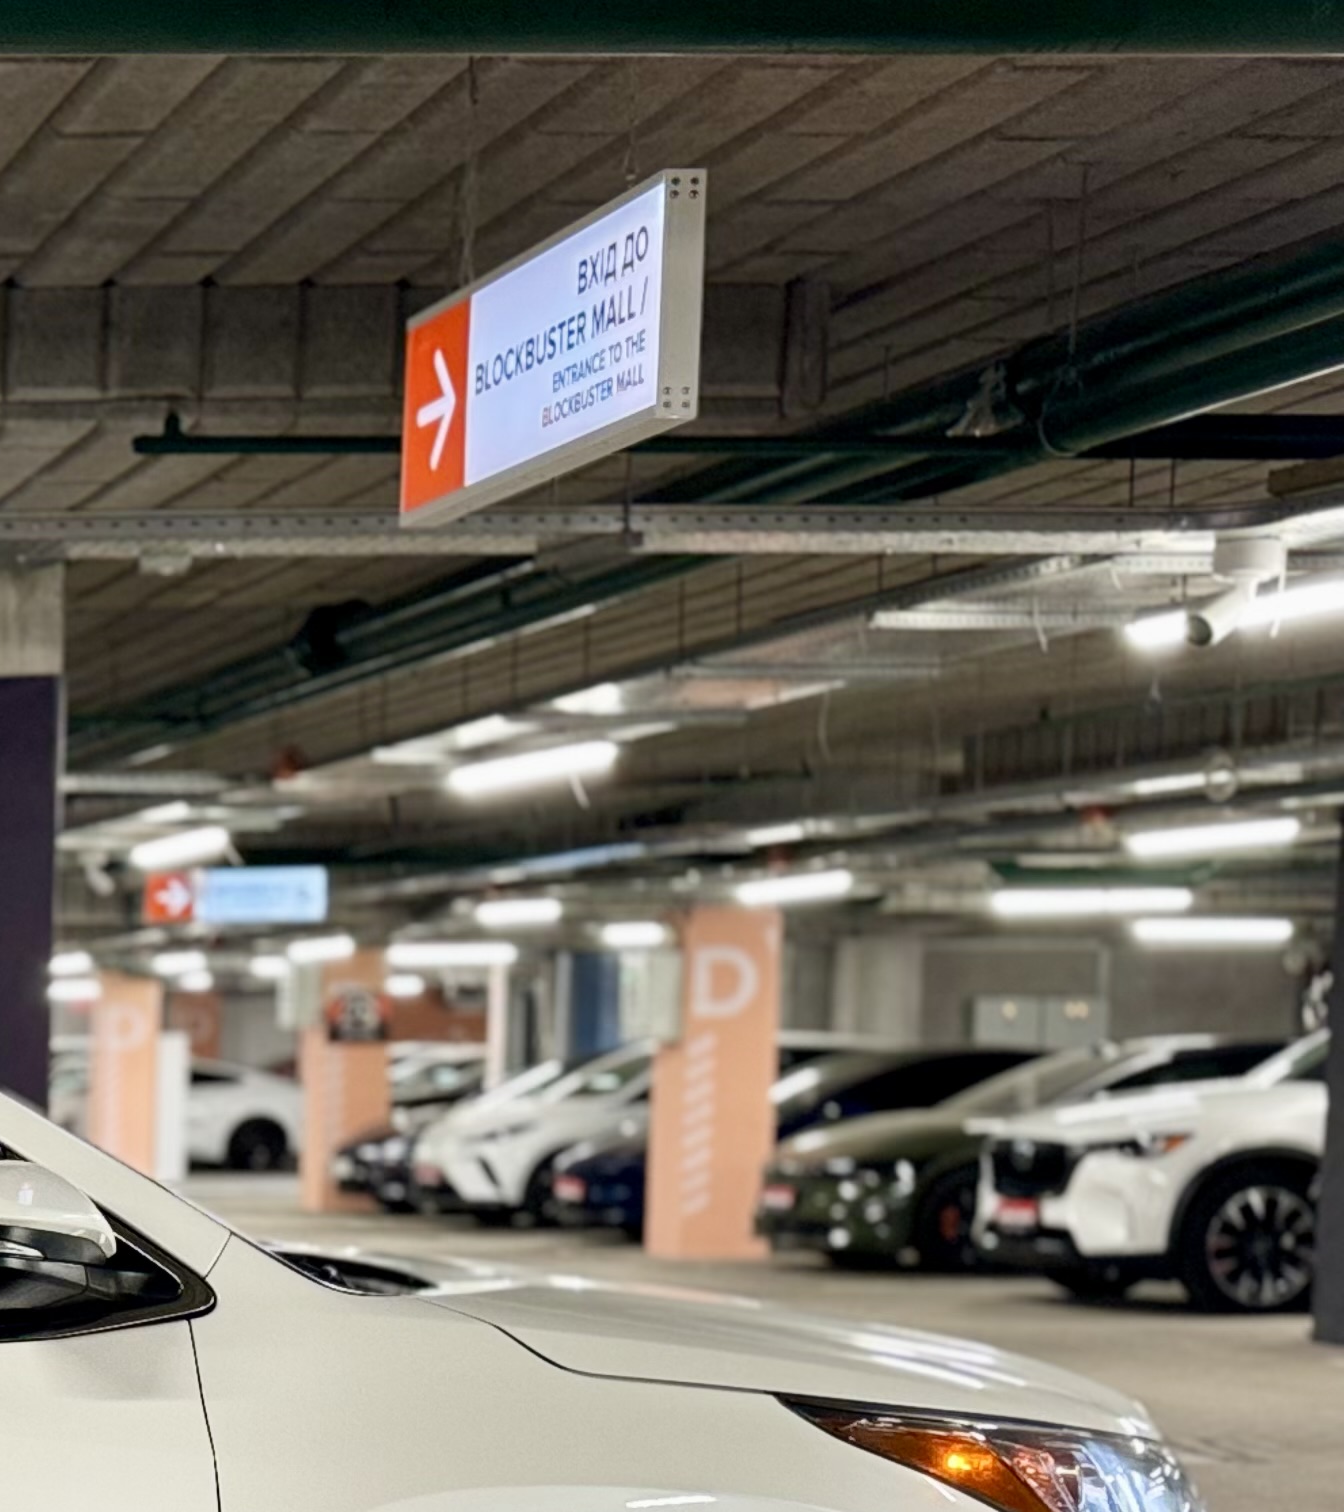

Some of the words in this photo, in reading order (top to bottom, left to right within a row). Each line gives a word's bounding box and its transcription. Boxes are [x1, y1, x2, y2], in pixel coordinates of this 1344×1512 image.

[577, 243, 617, 295] ВХІД
[622, 226, 649, 279] ДО
[474, 311, 587, 396] BLOCKBUSTER
[591, 290, 636, 340] MALL
[552, 349, 606, 393] ENTRANCE
[609, 343, 623, 367] TO
[625, 329, 646, 359] THE
[541, 378, 613, 428] BLOCKBUSTER
[616, 365, 645, 395] MALL
[692, 942, 760, 1019] D
